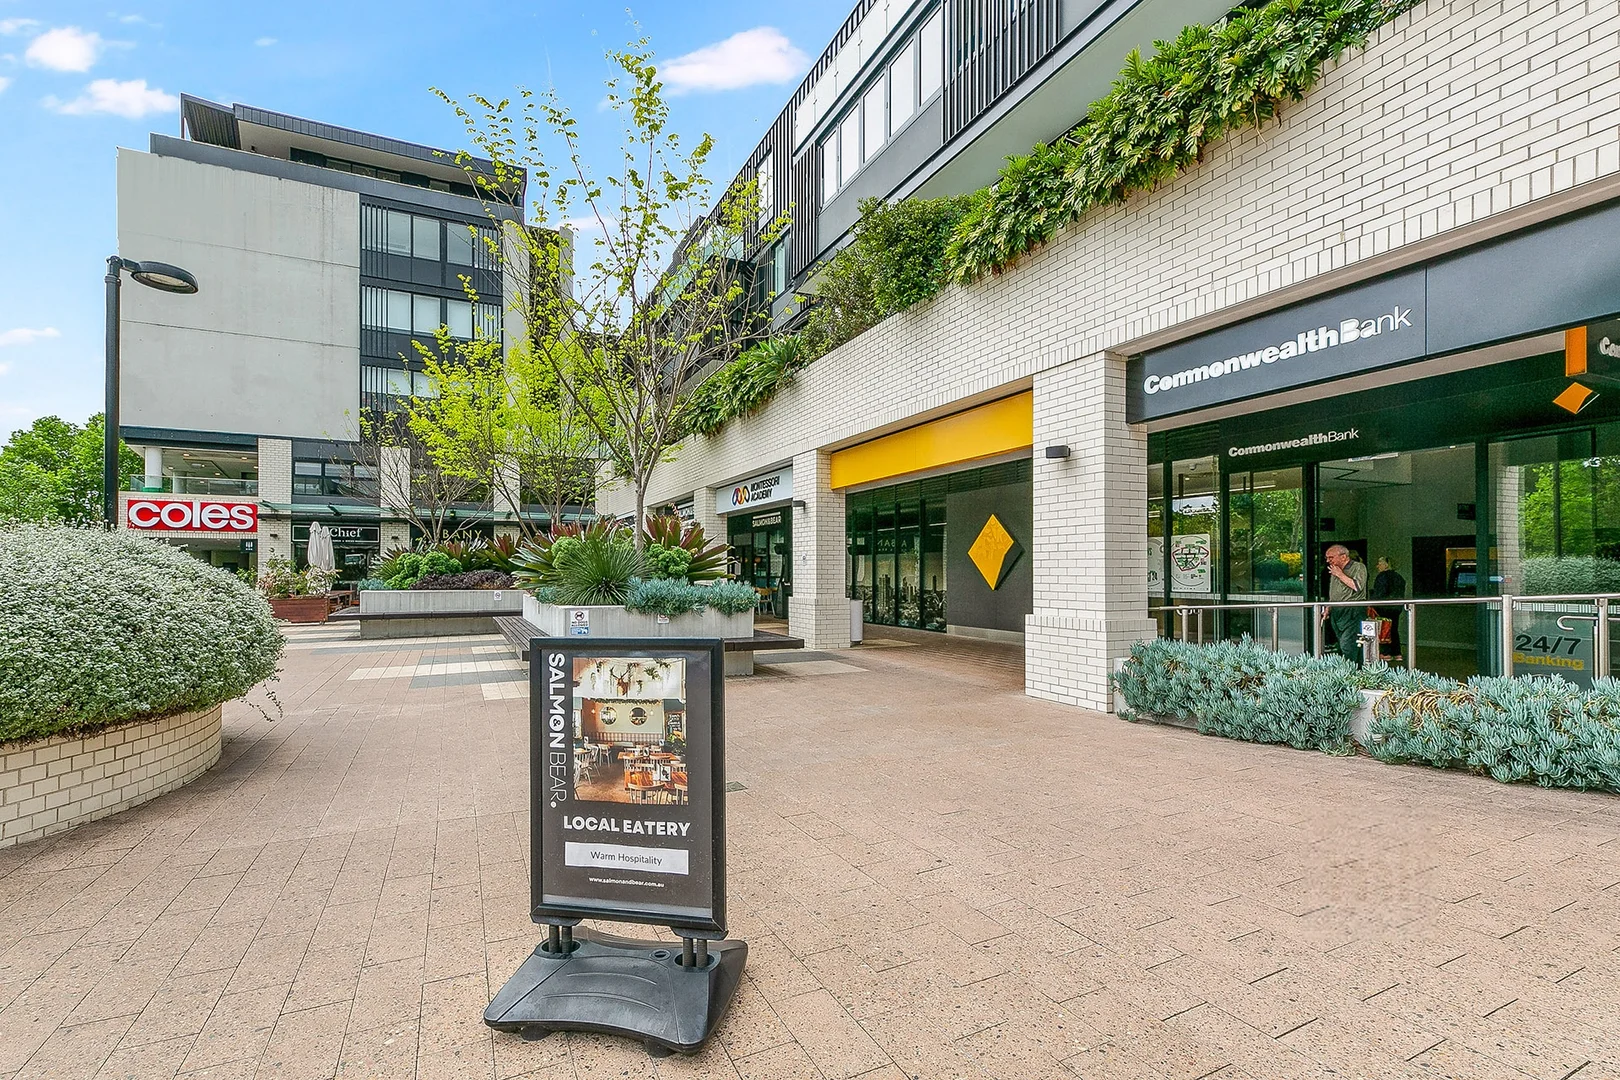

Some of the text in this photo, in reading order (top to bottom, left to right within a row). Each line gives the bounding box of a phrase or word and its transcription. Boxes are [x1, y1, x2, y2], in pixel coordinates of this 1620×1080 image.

[1143, 306, 1412, 395] CommonwealthBank
[1228, 428, 1360, 458] CommonwealthBank
[128, 500, 255, 530] coles
[330, 527, 363, 538] Chief
[1515, 634, 1582, 655] 24/7
[1512, 651, 1584, 671] Banking
[563, 815, 691, 837] LOCAL EATERY
[590, 851, 663, 866] Warm Hospitality
[588, 876, 665, 888] www.salmonandbear.com.au
